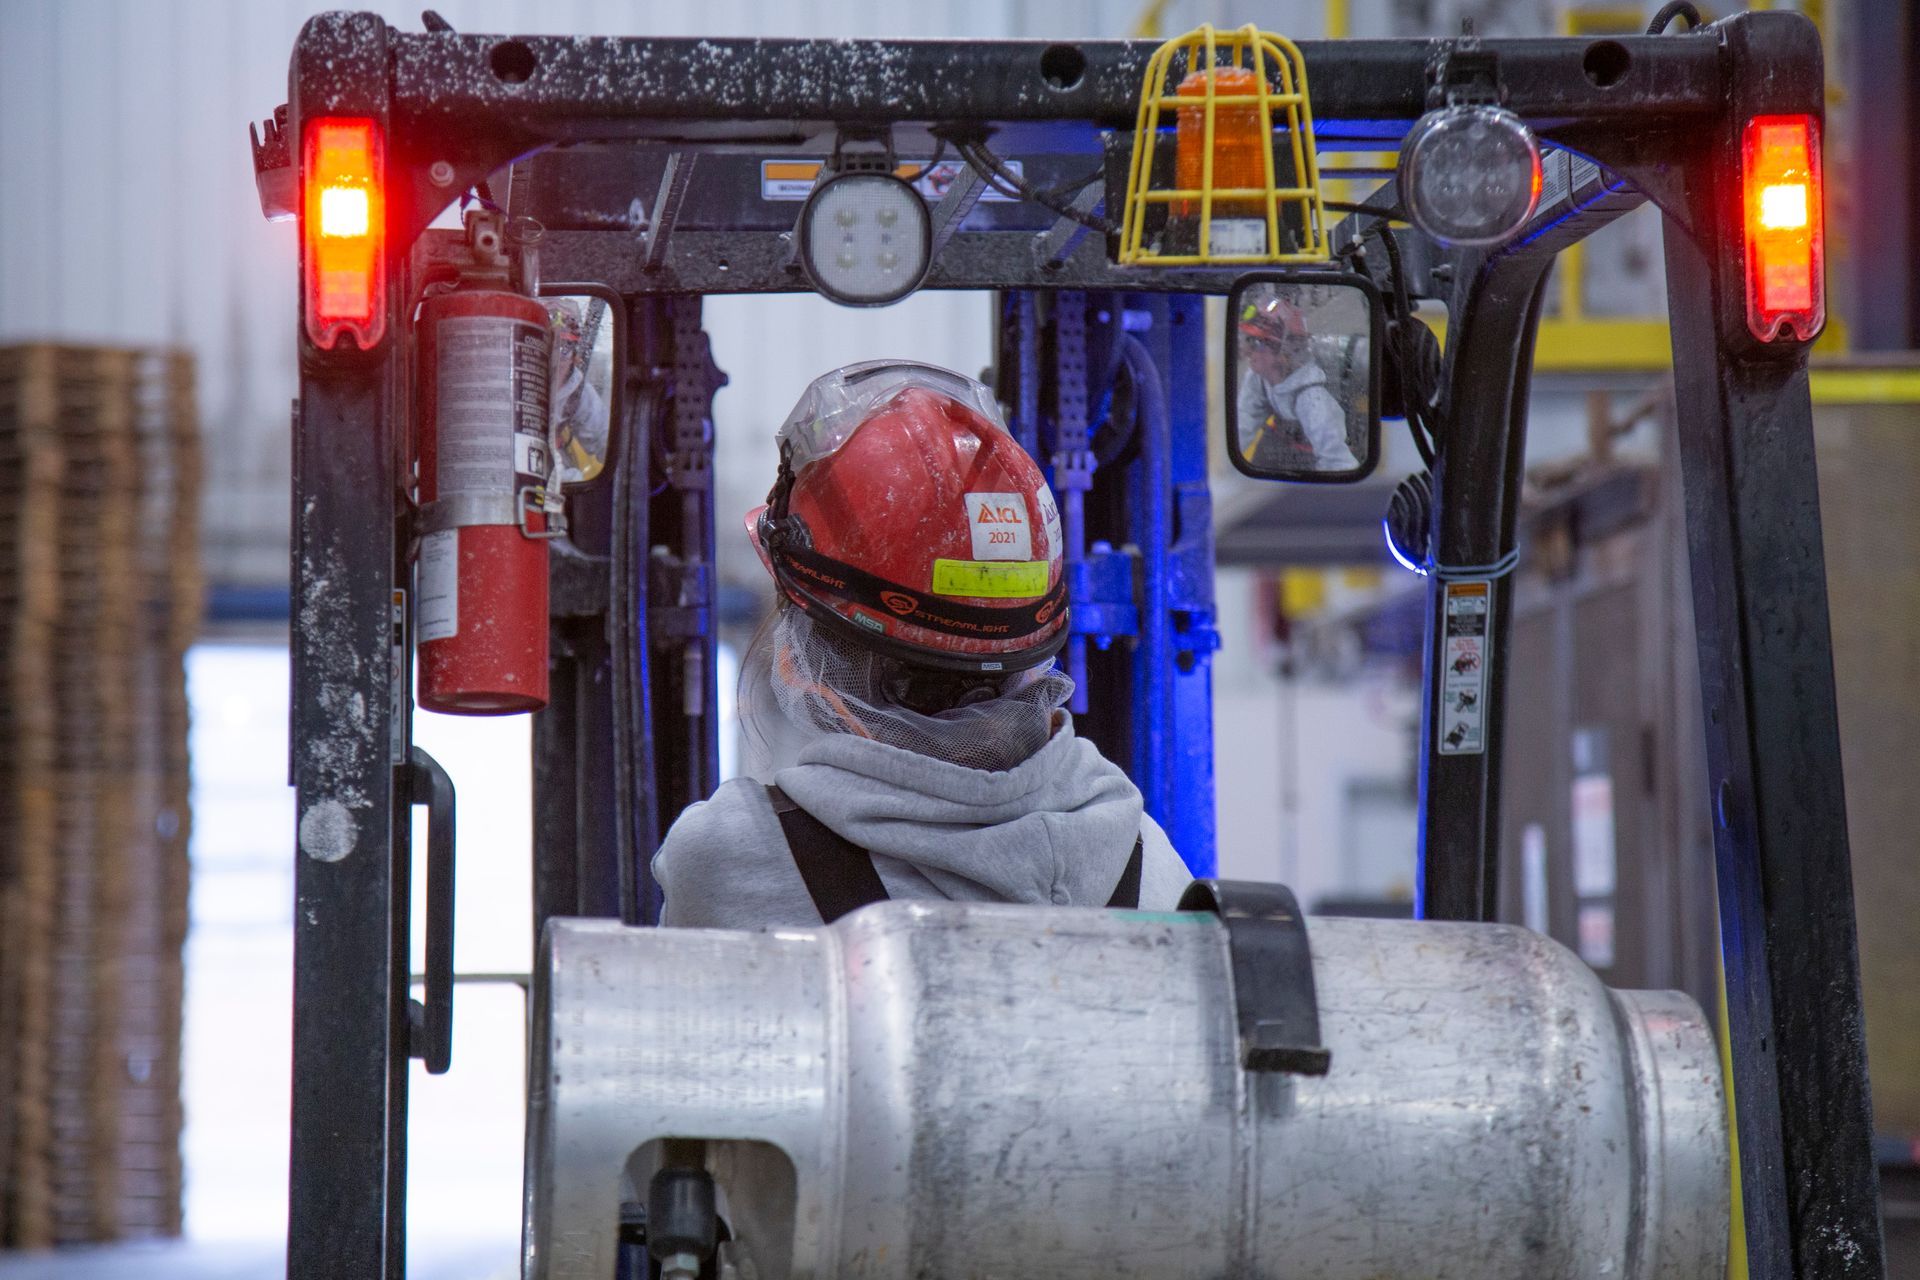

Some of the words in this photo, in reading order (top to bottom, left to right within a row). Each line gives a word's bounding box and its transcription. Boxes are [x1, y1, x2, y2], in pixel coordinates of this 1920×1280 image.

[988, 532, 1017, 544] 2021
[853, 611, 884, 634] MSA
[914, 609, 1011, 634] STREAMLIGHT
[982, 663, 1001, 671] MSA
